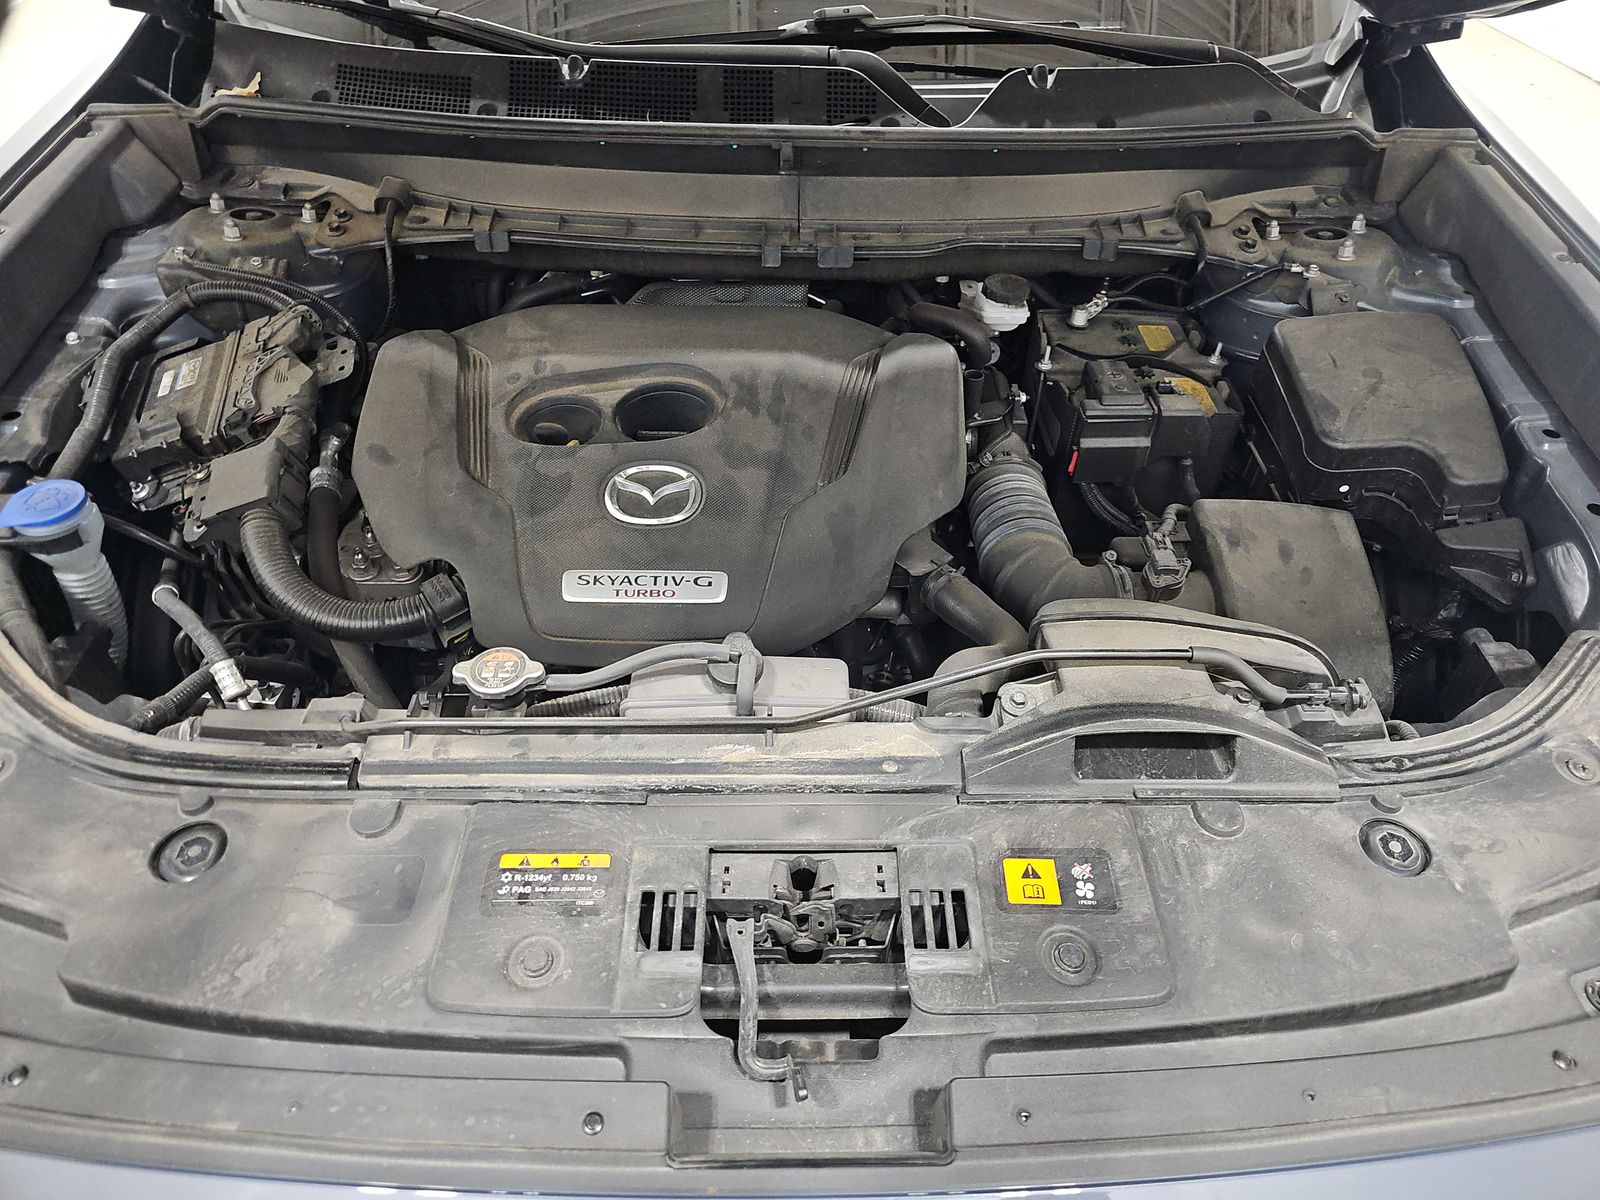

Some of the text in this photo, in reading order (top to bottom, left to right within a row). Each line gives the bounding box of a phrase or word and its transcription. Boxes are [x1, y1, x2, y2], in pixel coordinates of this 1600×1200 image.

[576, 574, 713, 588] SKYACTIV-G
[613, 588, 676, 598] TURBO
[514, 873, 598, 883] R-1234yf 0.750 kg
[511, 885, 532, 894] PAG
